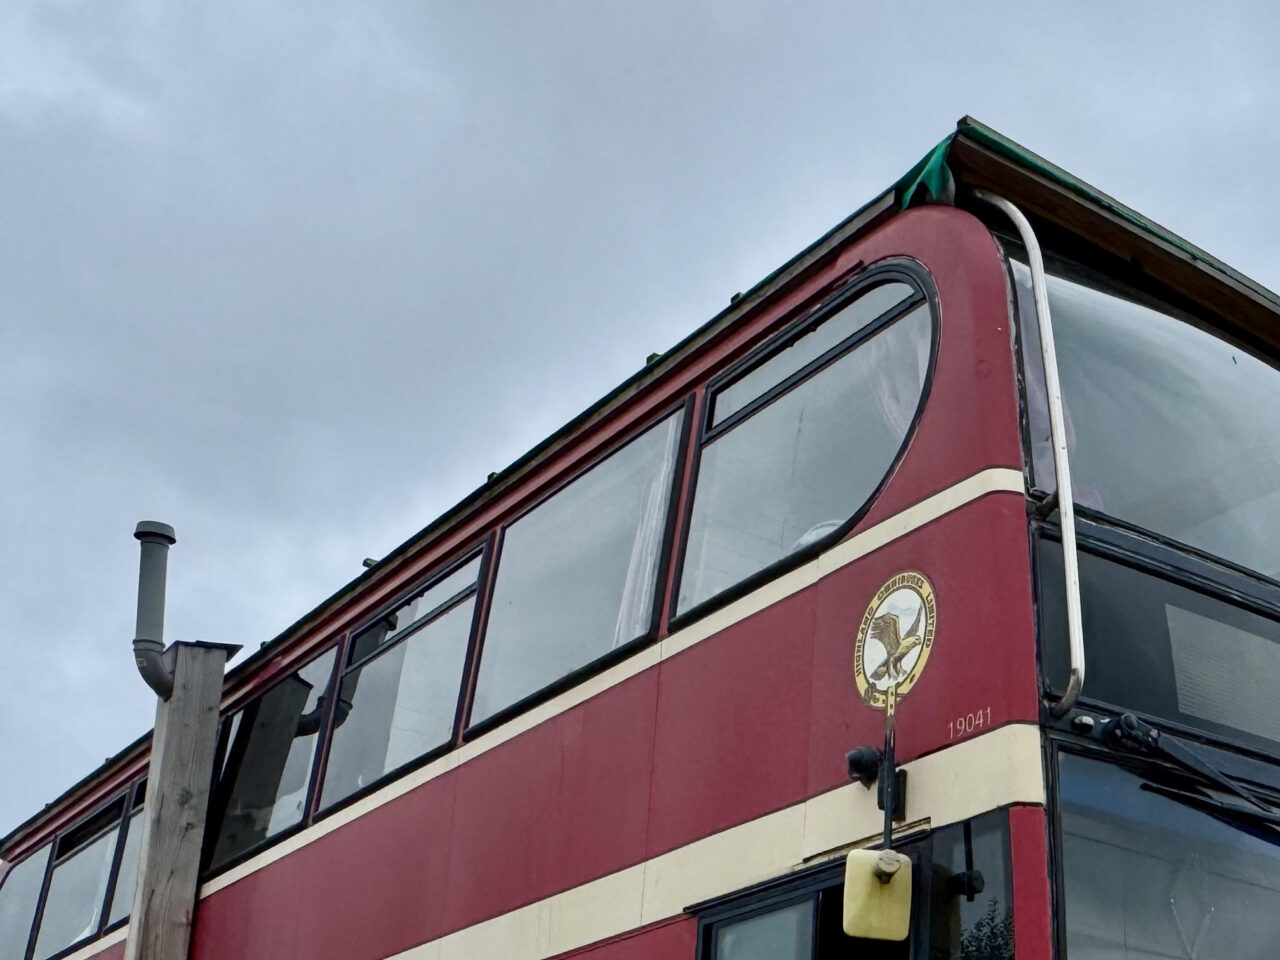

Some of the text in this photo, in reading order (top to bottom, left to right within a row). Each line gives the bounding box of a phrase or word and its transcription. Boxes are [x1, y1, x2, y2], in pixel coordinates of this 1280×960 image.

[855, 605, 874, 677] HIGHLAND
[925, 592, 936, 649] LIMITED
[948, 706, 991, 740] 19041
